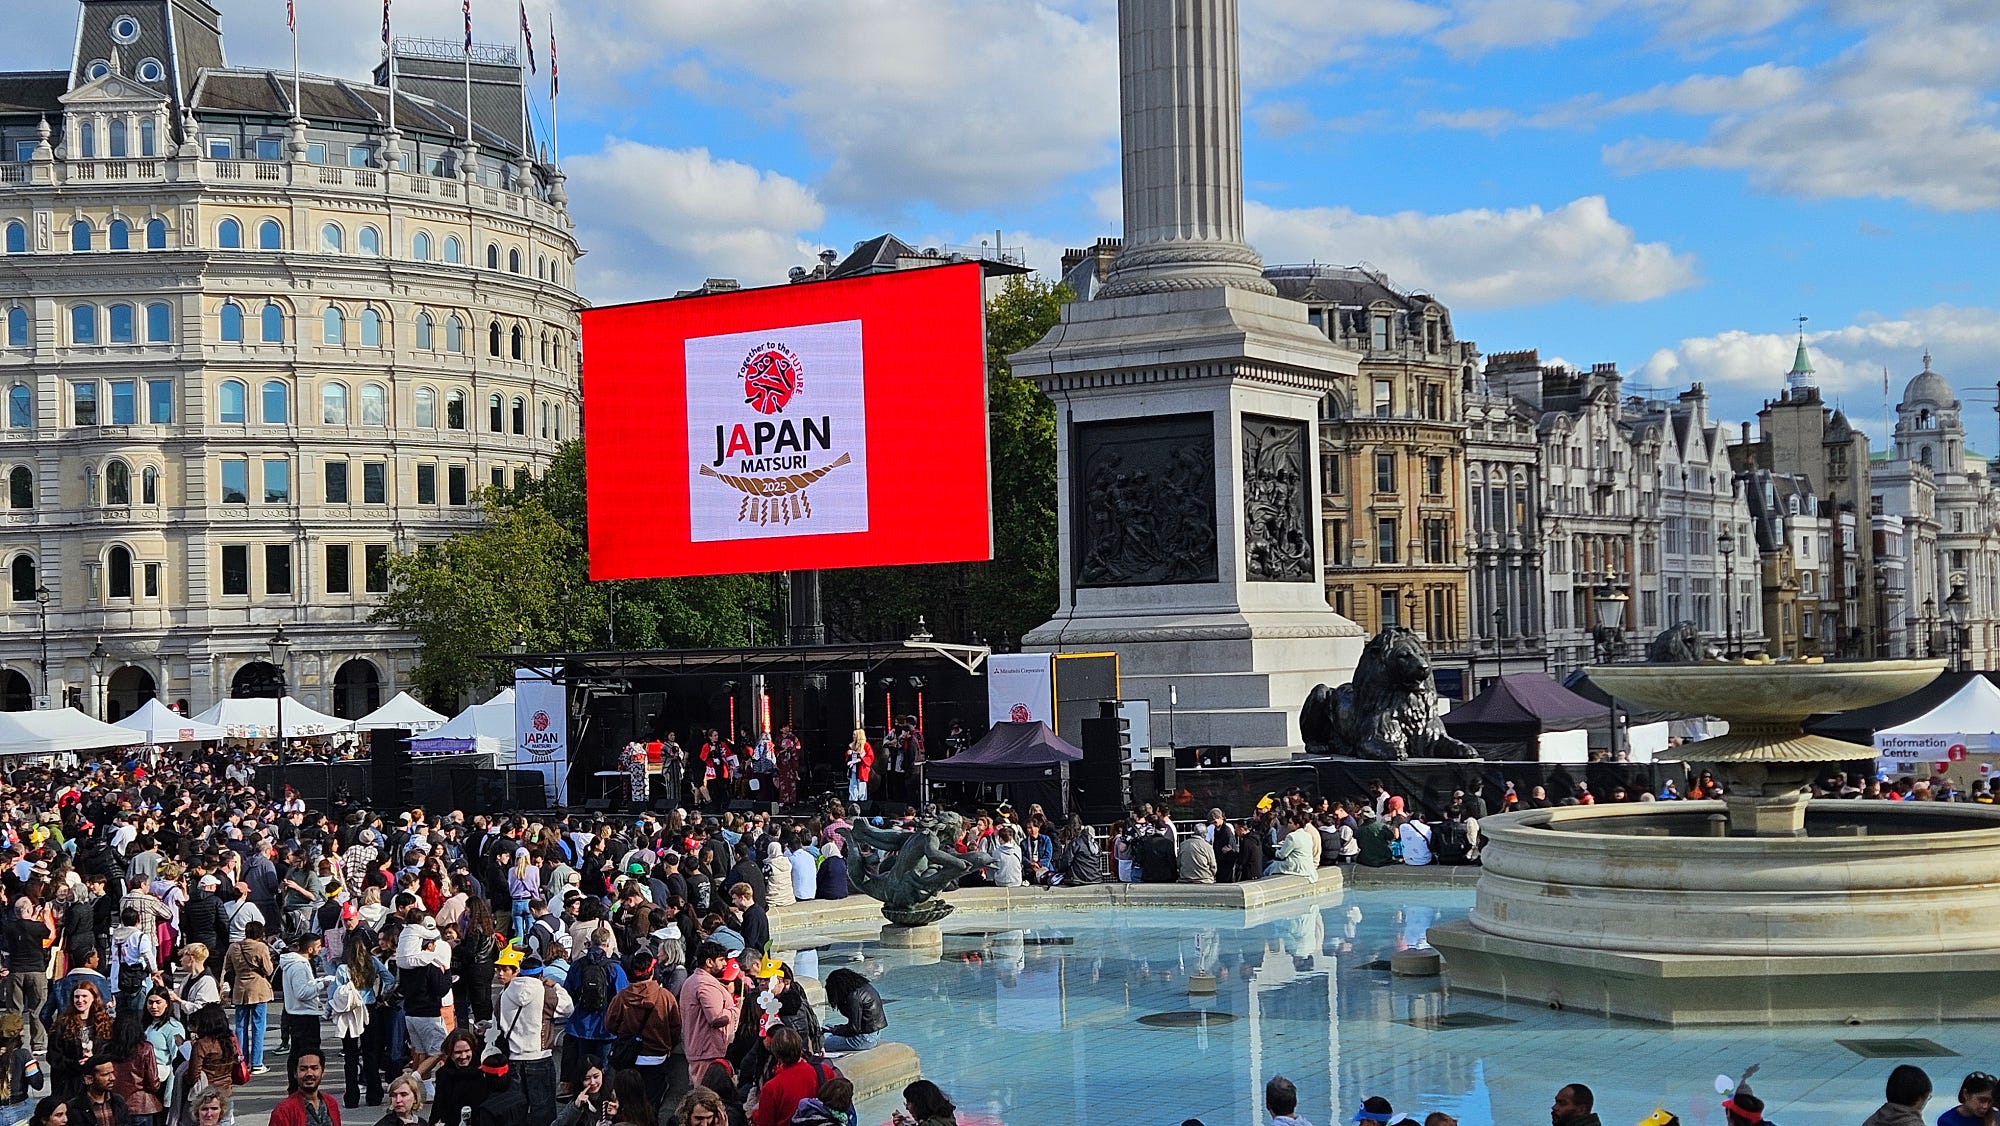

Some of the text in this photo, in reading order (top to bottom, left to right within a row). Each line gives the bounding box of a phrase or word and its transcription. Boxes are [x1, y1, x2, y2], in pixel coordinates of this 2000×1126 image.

[737, 341, 804, 395] Together to the FUTURE
[713, 416, 831, 467] JAPAN
[741, 455, 807, 473] MATSURI
[762, 481, 787, 492] 2025
[524, 733, 558, 746] JAPAN
[1882, 737, 1947, 747] Information
[1882, 749, 1919, 758] Centre
